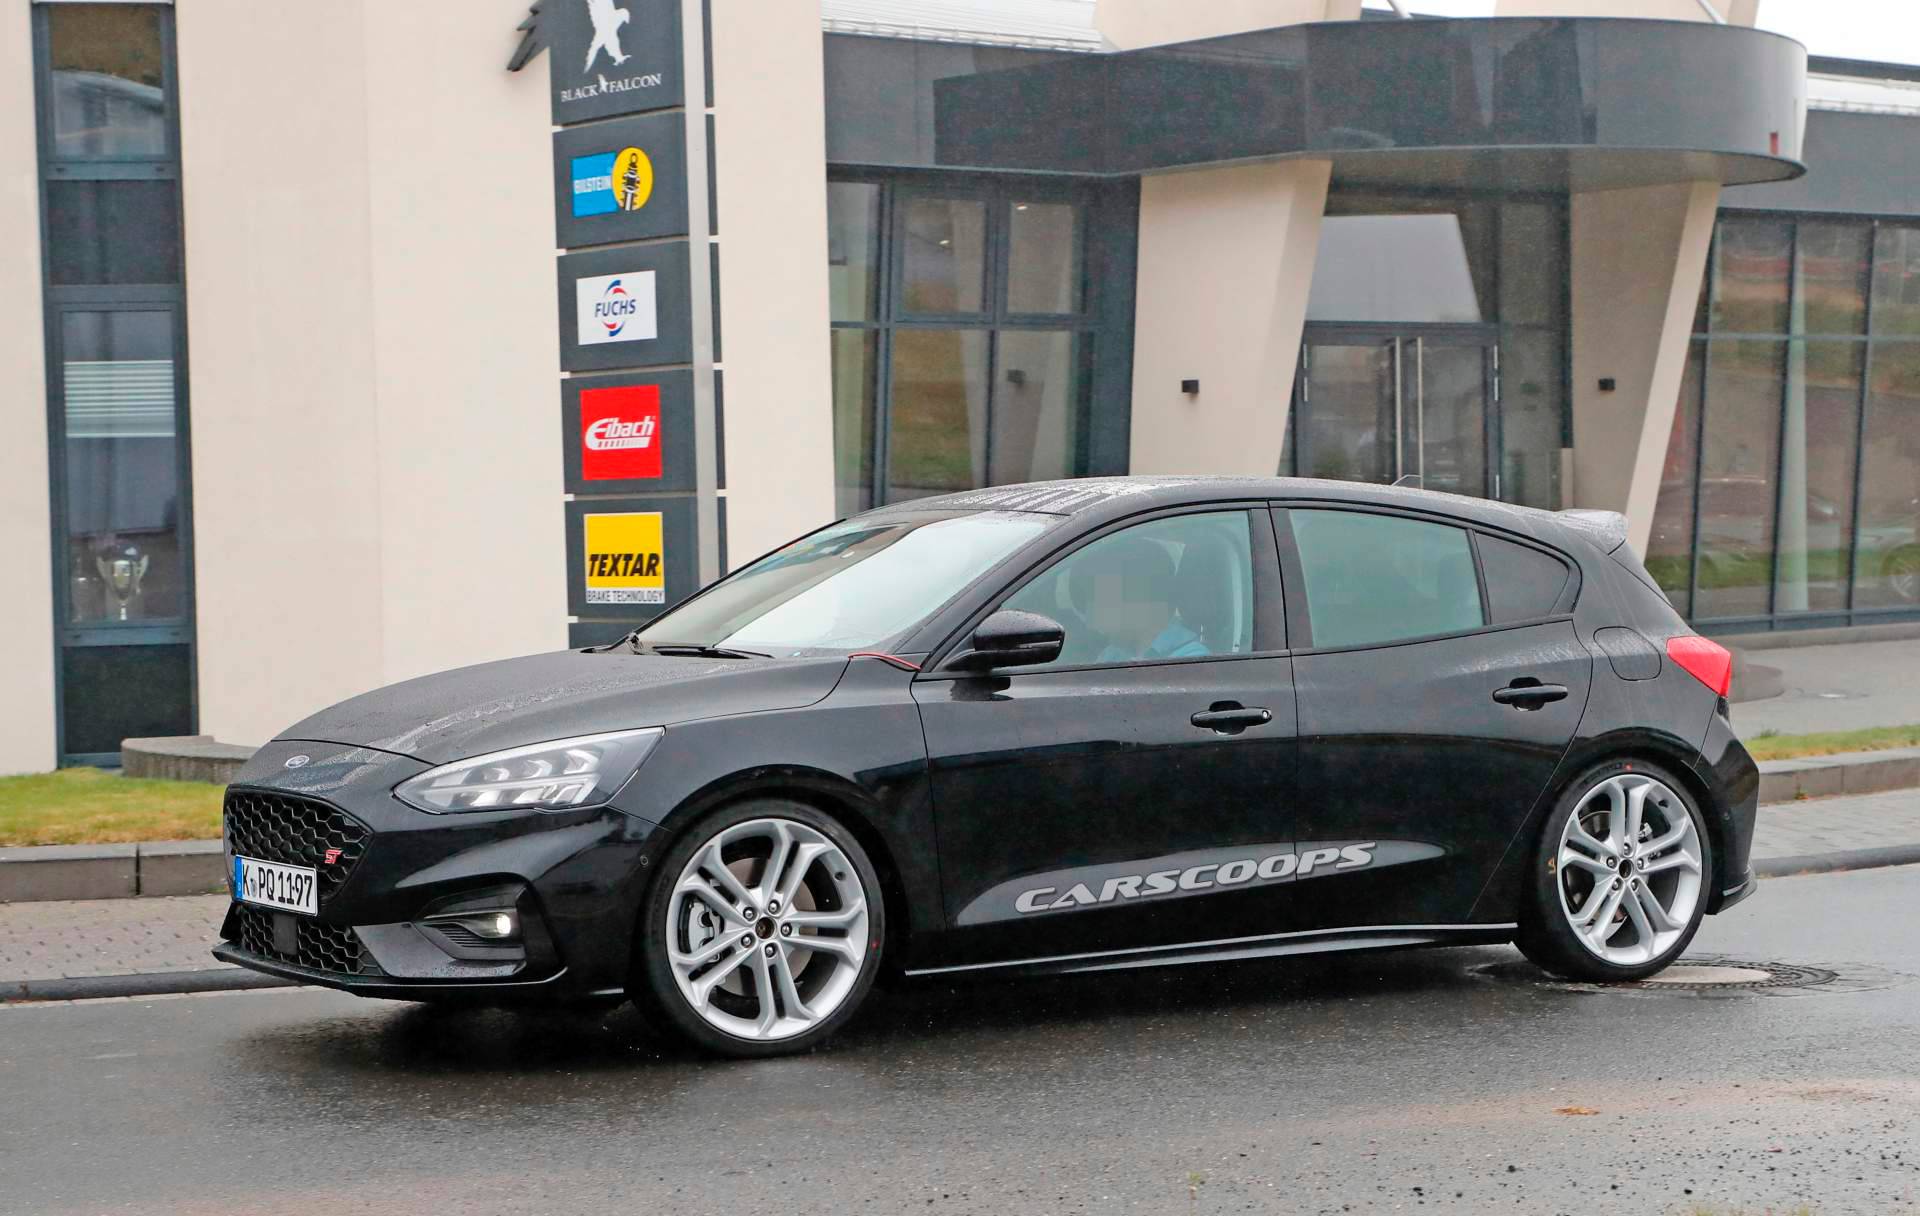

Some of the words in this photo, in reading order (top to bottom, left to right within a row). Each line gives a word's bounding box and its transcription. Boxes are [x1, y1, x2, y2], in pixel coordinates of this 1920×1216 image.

[561, 84, 599, 102] BLACK
[609, 73, 662, 93] FALCON
[594, 299, 636, 317] FUCHS
[585, 416, 656, 451] Eibach
[588, 553, 660, 577] TEXTAR
[586, 590, 611, 602] BRAKE
[612, 590, 664, 602] TECHNOLOGY
